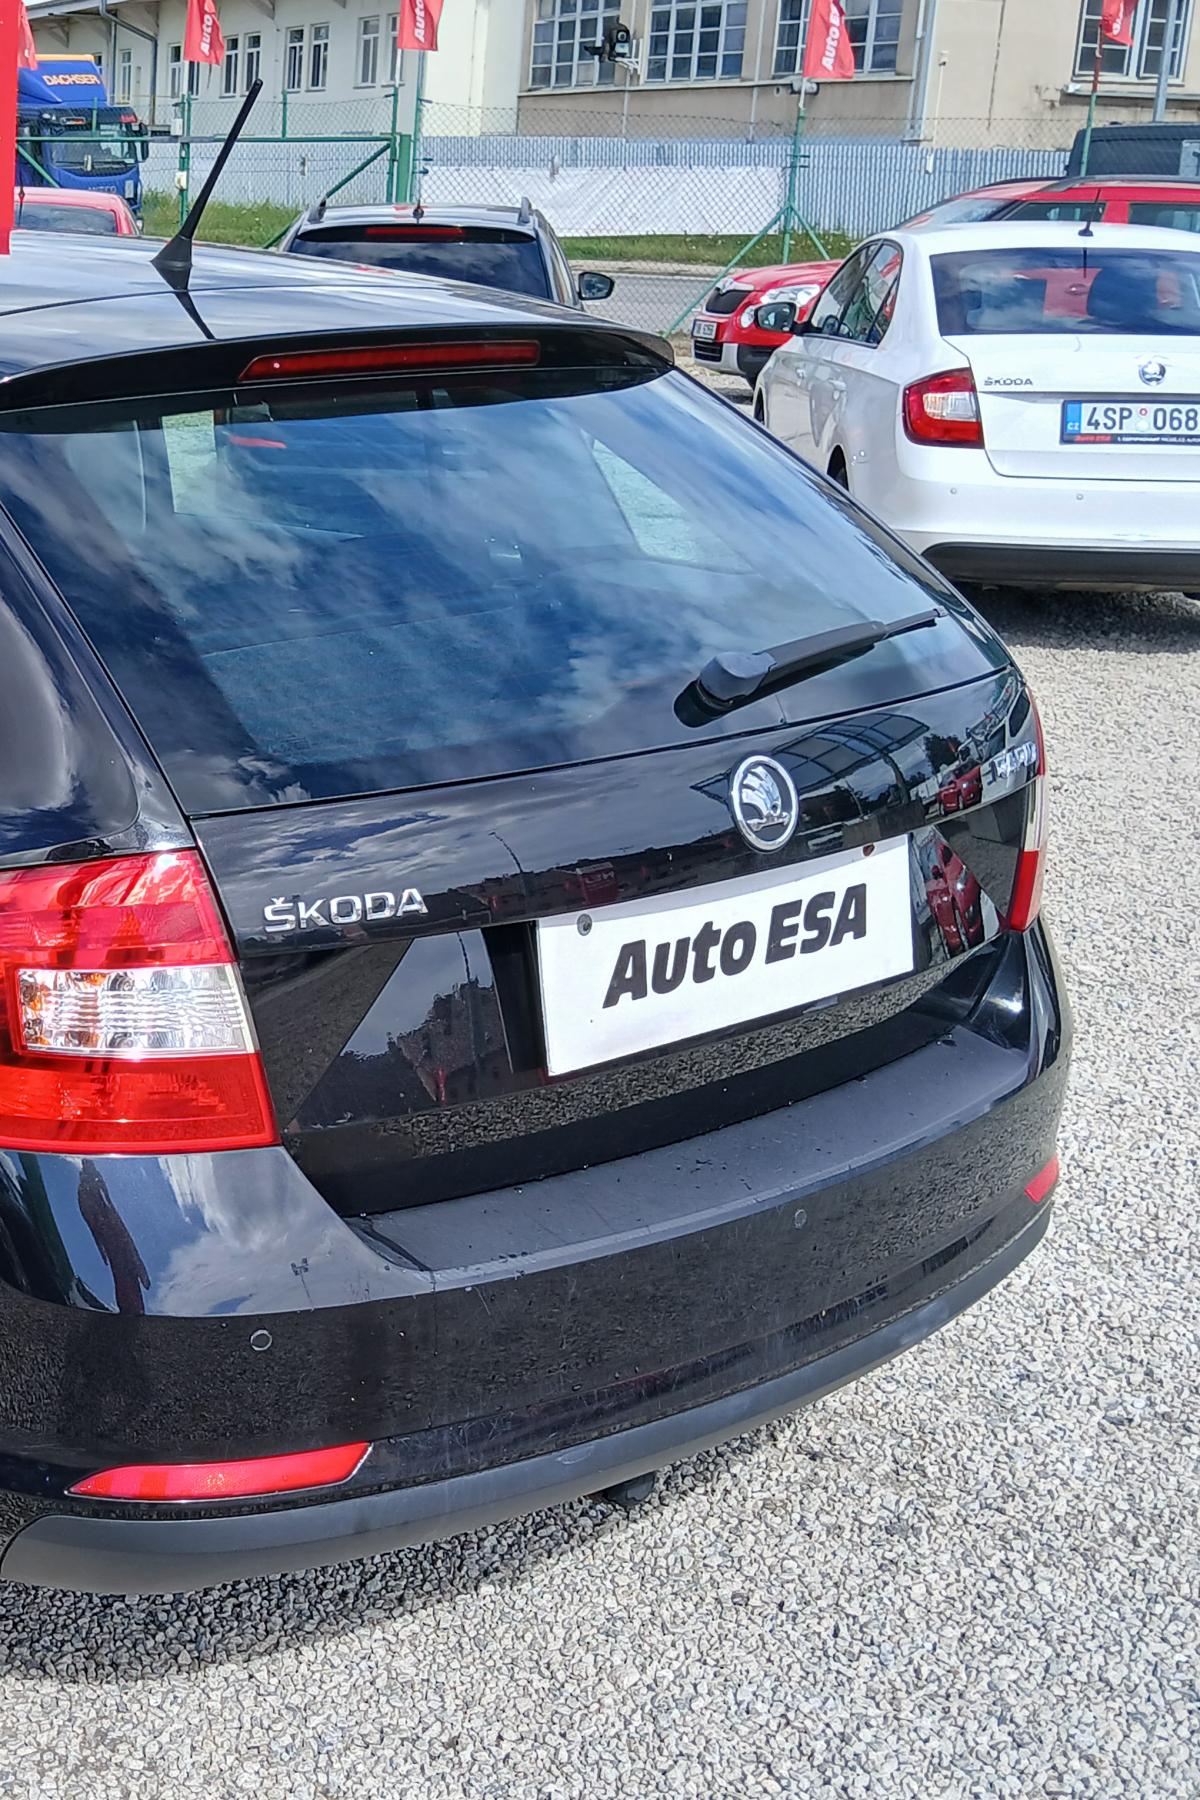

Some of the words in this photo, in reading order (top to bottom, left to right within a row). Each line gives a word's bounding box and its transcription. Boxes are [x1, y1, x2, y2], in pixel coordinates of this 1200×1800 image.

[200, 14, 212, 57] Auto
[821, 26, 840, 71] Auto
[42, 74, 100, 86] DACHSER
[984, 376, 1033, 386] ŠKODA
[1087, 407, 1133, 430] 4SP
[1153, 408, 1198, 431] 068
[263, 888, 429, 933] ŠKODA
[602, 920, 756, 1009] Auto
[765, 883, 867, 964] ESA
